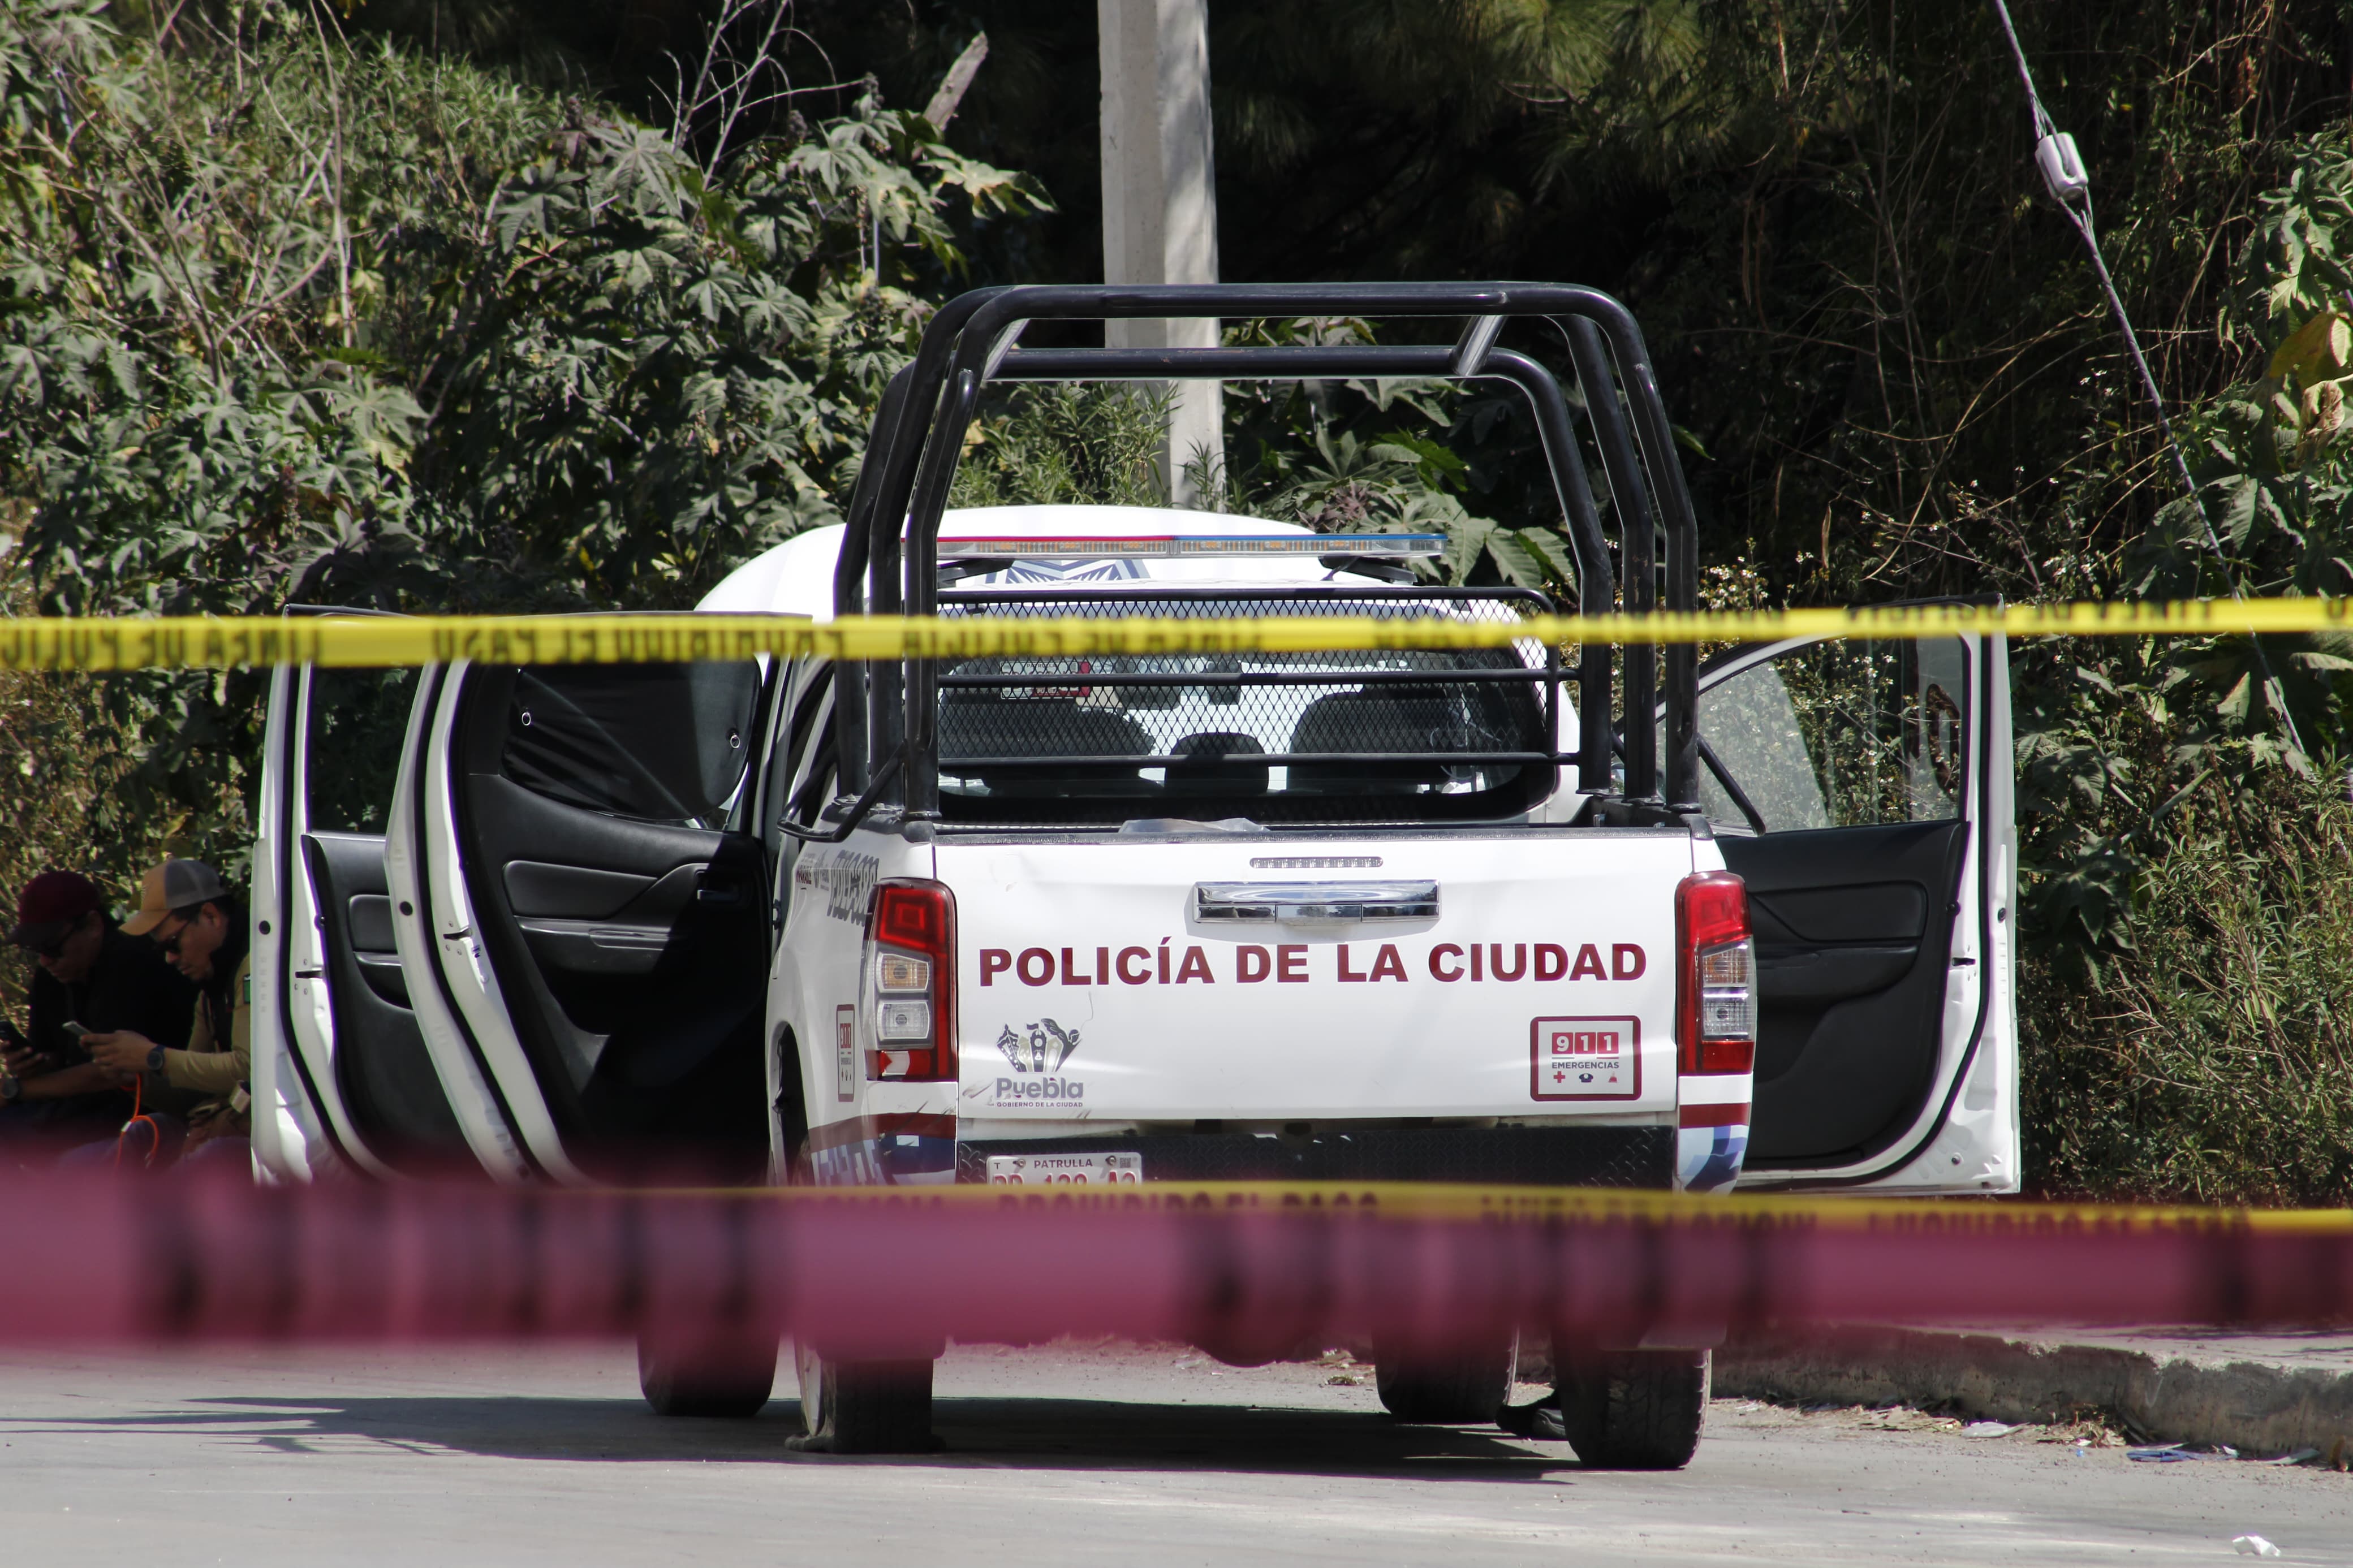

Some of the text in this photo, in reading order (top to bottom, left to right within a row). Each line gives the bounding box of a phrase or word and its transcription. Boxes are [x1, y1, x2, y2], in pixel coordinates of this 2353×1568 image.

[979, 936, 1647, 987] POLICÍA DE LA CIUDAD
[1556, 1035, 1612, 1052] 911
[996, 1077, 1084, 1099] Puebla
[1034, 1159, 1093, 1169] PATRULLA
